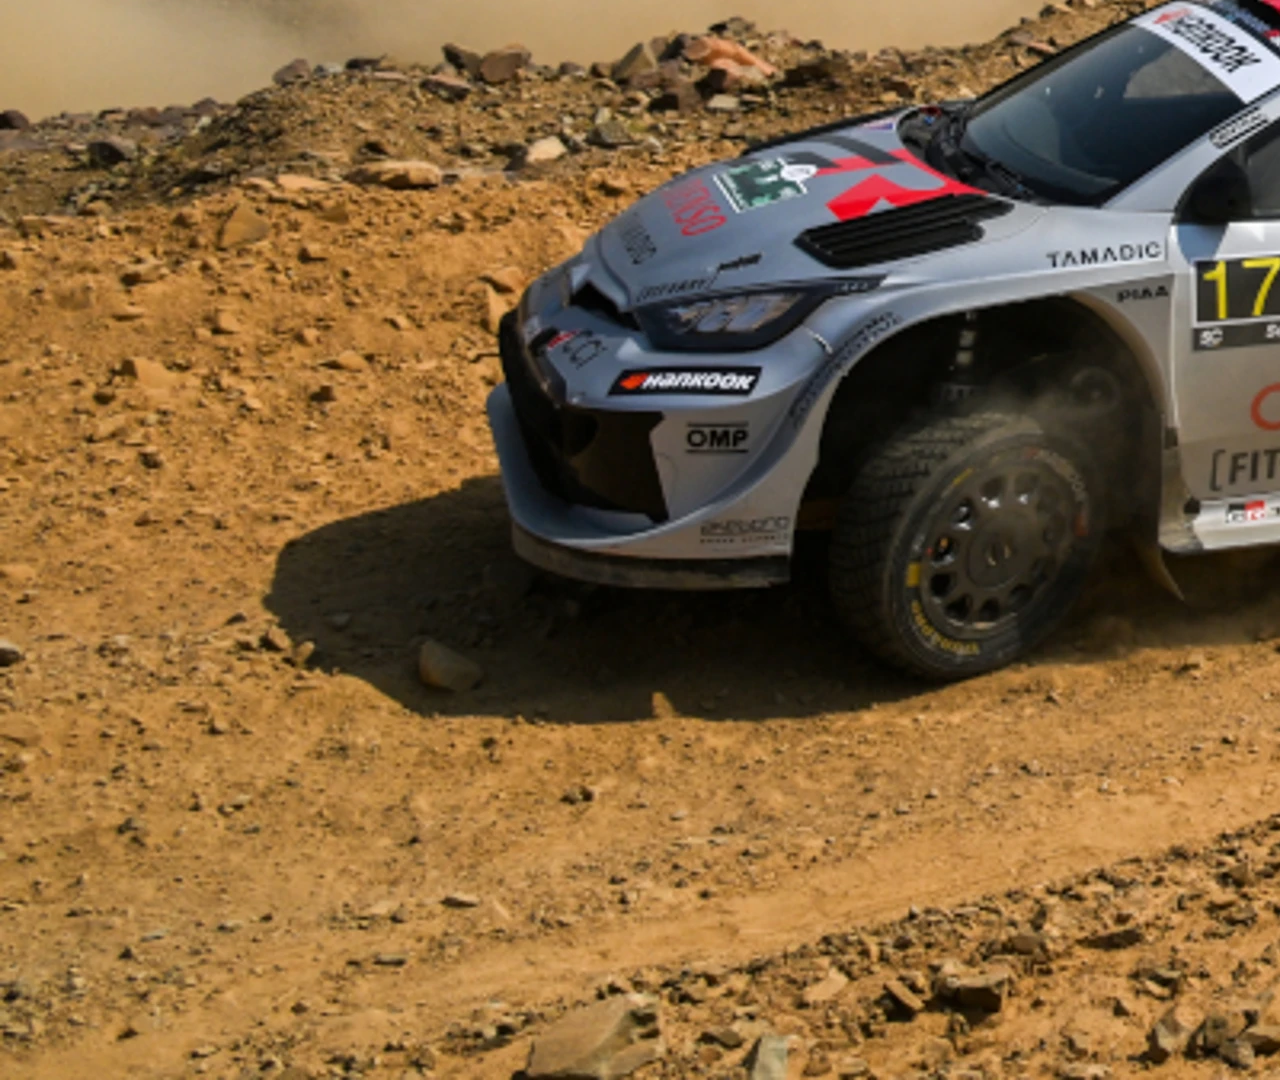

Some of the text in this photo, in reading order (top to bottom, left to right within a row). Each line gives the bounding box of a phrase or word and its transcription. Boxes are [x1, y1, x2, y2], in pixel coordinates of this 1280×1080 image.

[1046, 241, 1162, 268] TAMADIC
[1116, 285, 1170, 304] PIAA
[686, 428, 749, 448] OMP
